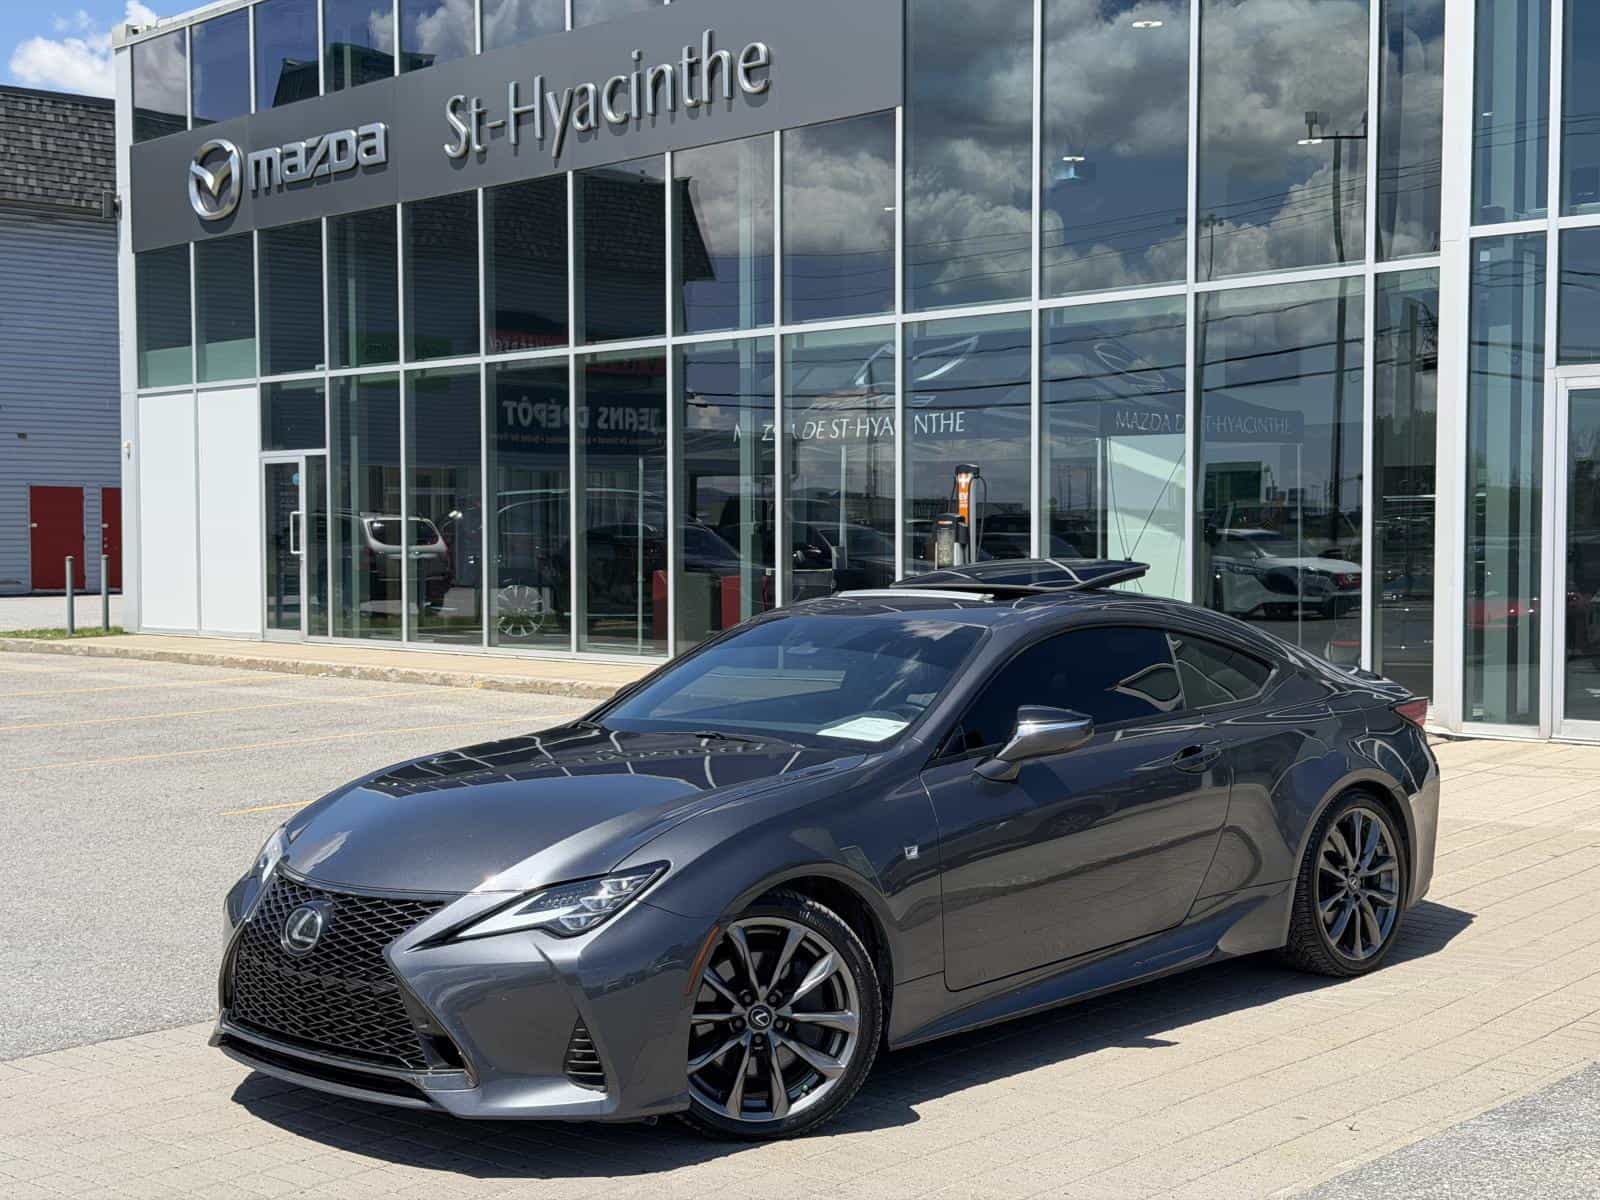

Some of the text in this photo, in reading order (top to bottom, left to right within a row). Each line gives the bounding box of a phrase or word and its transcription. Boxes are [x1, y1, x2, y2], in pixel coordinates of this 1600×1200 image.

[444, 28, 770, 159] St-Hyacinthe
[829, 411, 965, 440] ST-HYANTHE
[1115, 411, 1171, 432] MAZDA
